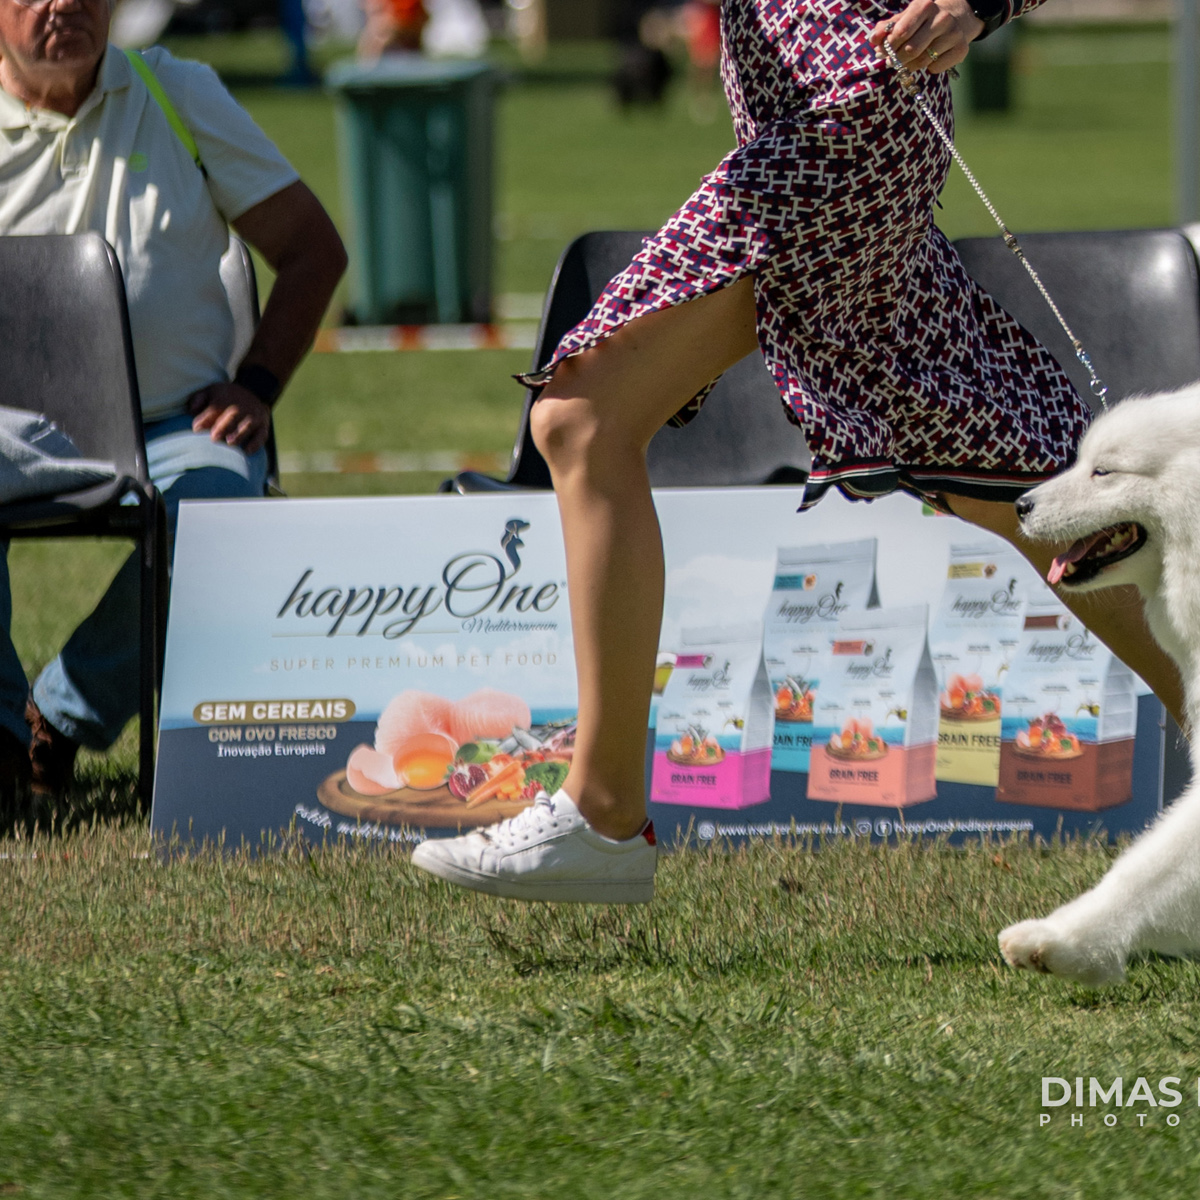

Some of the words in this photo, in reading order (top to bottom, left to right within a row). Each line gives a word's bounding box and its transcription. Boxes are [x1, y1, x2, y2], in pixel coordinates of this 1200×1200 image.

[276, 552, 561, 640] happyOne
[269, 657, 335, 672] SUPER
[347, 655, 445, 670] PREMIUM
[456, 654, 492, 668] PET
[504, 653, 558, 667] FOOD
[200, 702, 246, 721] SEM
[252, 701, 347, 720] CEREAIS
[208, 726, 242, 742] COM
[245, 725, 275, 741] OVO
[278, 724, 337, 741] FRESCO
[772, 734, 794, 747] RAIN
[796, 735, 813, 748] FRE
[972, 735, 1001, 748] FREE
[217, 743, 272, 758] Inovação
[670, 773, 694, 784] GRAIN
[695, 774, 717, 786] FREE
[829, 768, 856, 780] GRAIN
[857, 770, 880, 782] FREE
